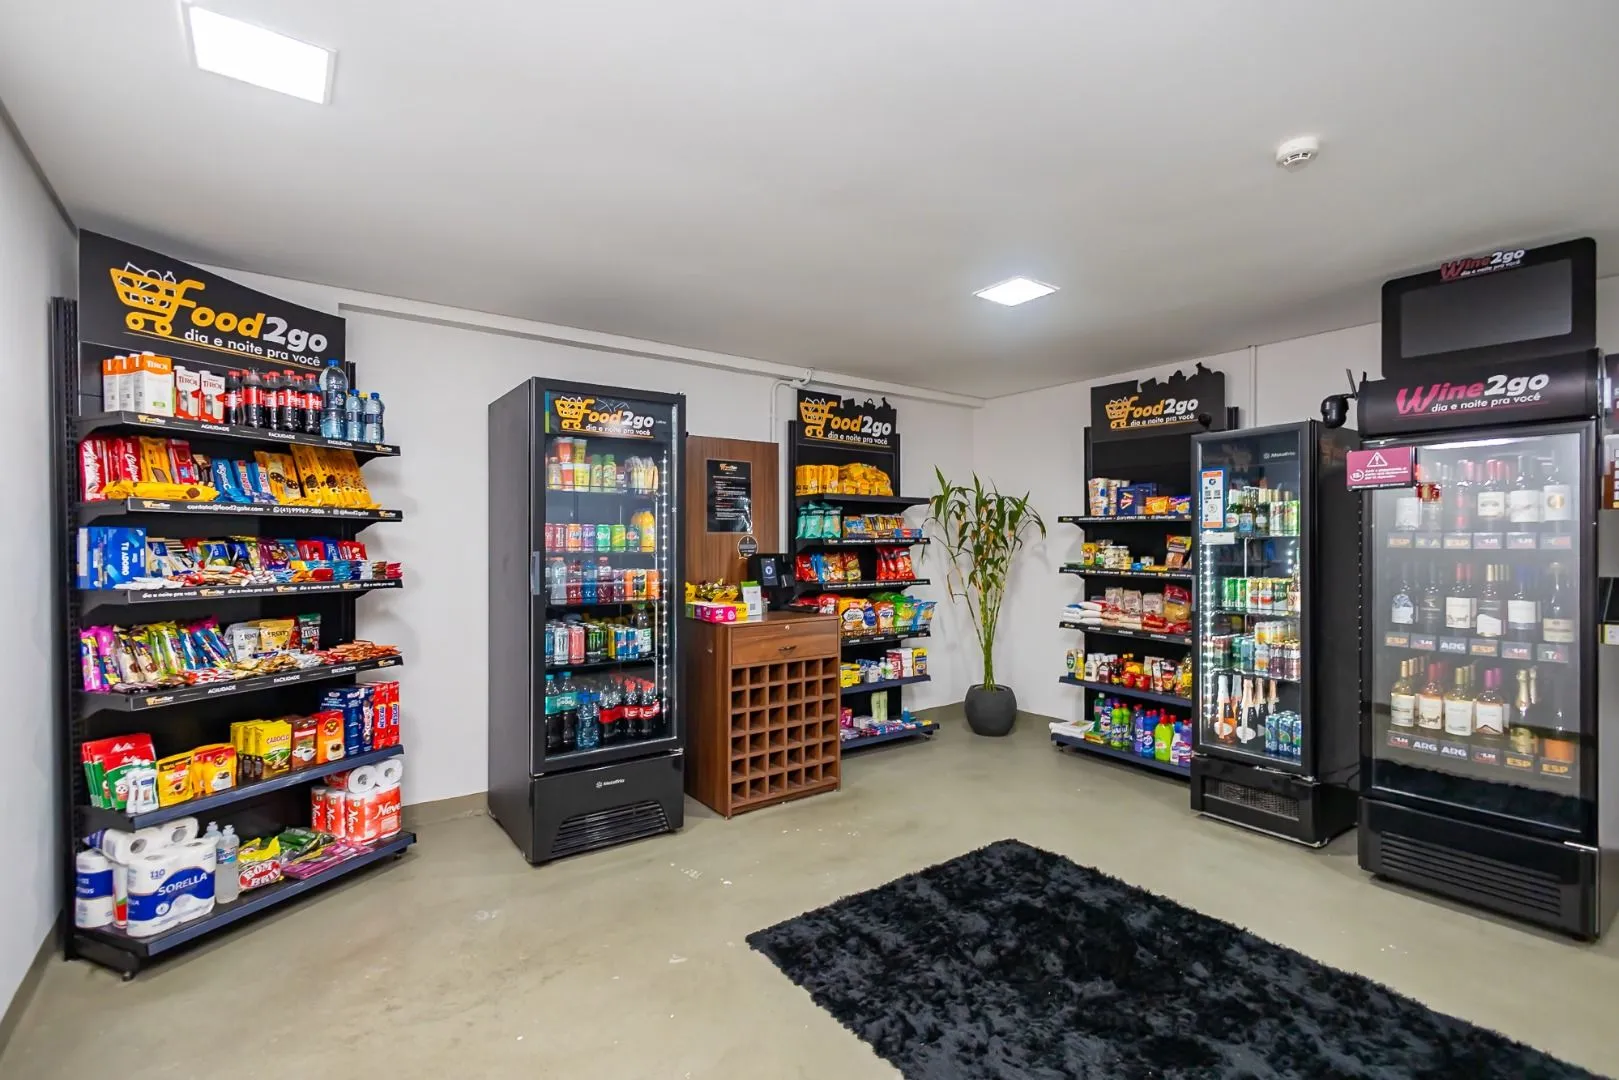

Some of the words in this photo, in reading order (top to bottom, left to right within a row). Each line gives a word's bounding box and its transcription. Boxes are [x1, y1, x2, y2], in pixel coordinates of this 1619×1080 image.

[184, 329, 208, 344] dia
[213, 336, 223, 346] e
[228, 336, 263, 355] noite
[266, 348, 289, 362] pra
[292, 350, 321, 366] você
[1395, 374, 1550, 414] Wine2go
[1431, 402, 1448, 413] dia
[1460, 398, 1488, 409] noite
[1490, 397, 1510, 408] pra
[1512, 391, 1541, 404] você
[1130, 418, 1140, 426] dia
[1147, 416, 1164, 424] noite
[1165, 415, 1177, 423] pra
[1178, 412, 1194, 420] você
[635, 428, 650, 436] você
[828, 430, 838, 440] dia
[845, 434, 862, 442] noite
[874, 437, 888, 445] você
[1413, 741, 1438, 751] ARG
[1441, 746, 1467, 757] ARG
[374, 802, 401, 820] Neve
[150, 868, 166, 879] 110
[243, 863, 273, 880] BOM
[157, 872, 208, 896] SORELLA
